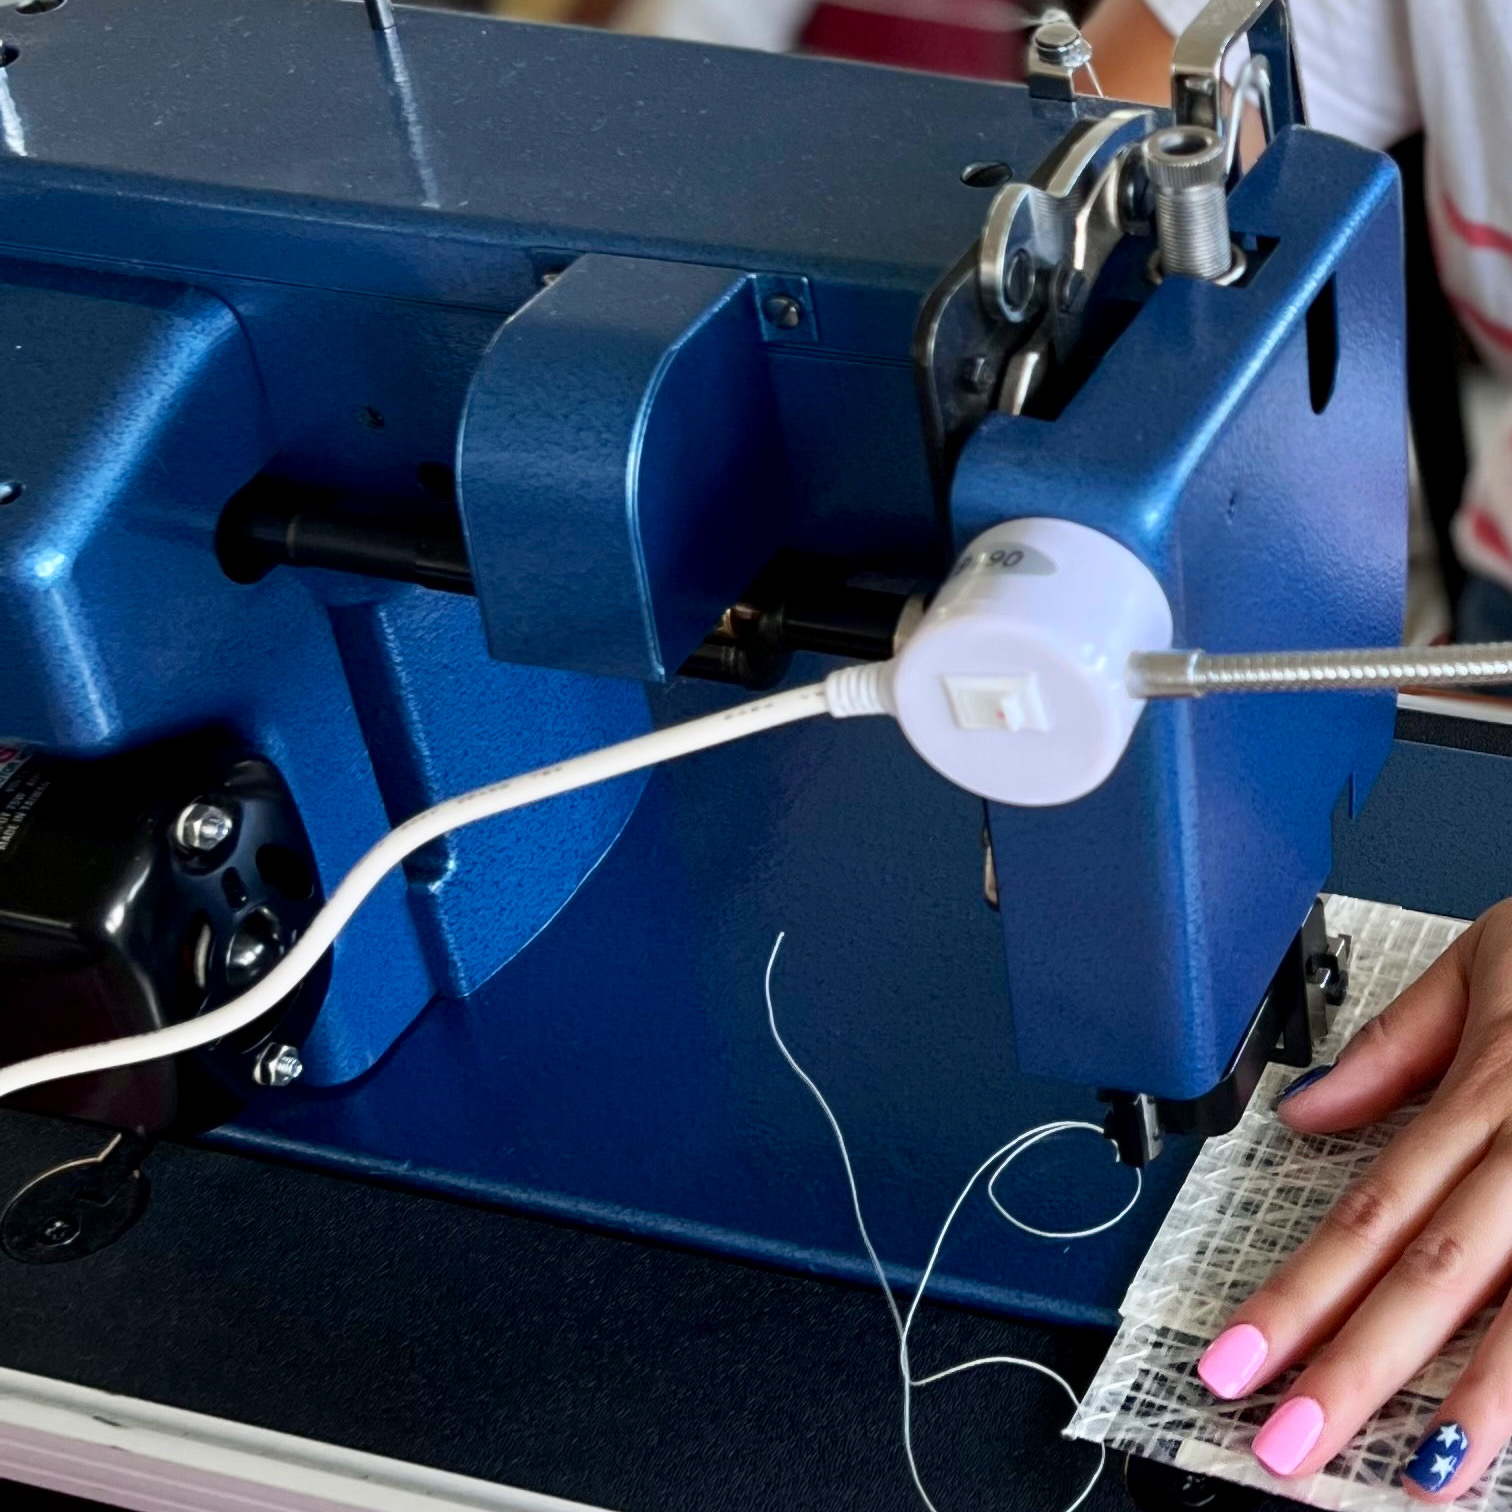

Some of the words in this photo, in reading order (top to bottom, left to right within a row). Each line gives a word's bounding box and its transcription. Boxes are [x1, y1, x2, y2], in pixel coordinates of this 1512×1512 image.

[0, 825, 20, 851] MADE
[11, 811, 27, 824] IN
[20, 781, 52, 811] TAIWAN
